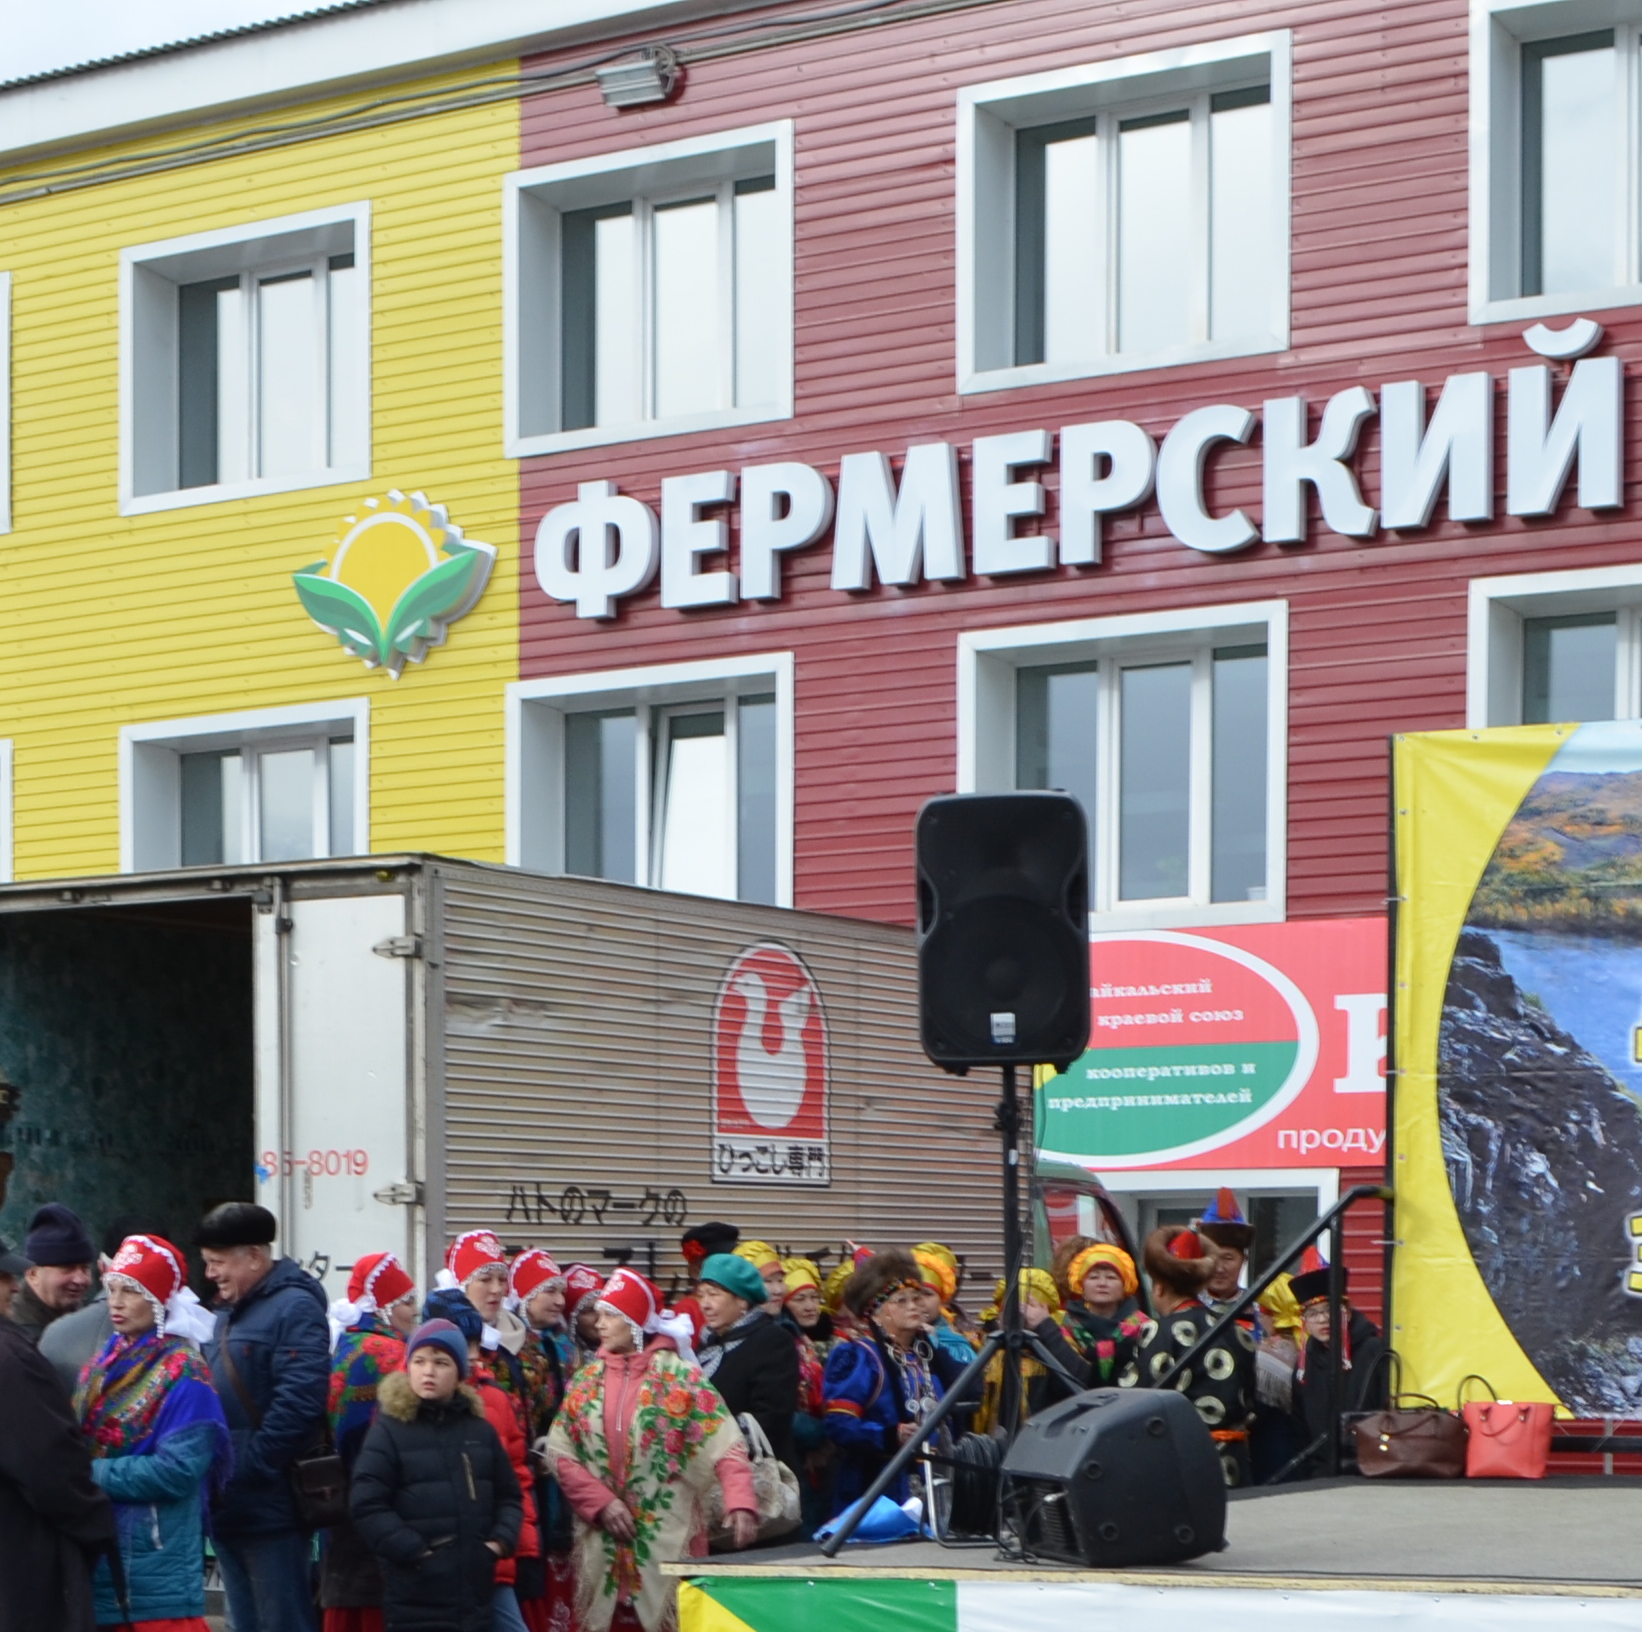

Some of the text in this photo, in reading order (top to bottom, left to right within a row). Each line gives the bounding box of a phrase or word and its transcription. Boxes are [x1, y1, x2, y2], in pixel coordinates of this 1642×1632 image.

[533, 317, 1624, 619] ФЕРМЕРСКИЙ
[1097, 1008, 1244, 1030] краевой союз
[1086, 1062, 1256, 1082] кооперативов и
[1047, 1088, 1253, 1113] предпринимателей
[506, 1182, 689, 1226] ハトのマークの
